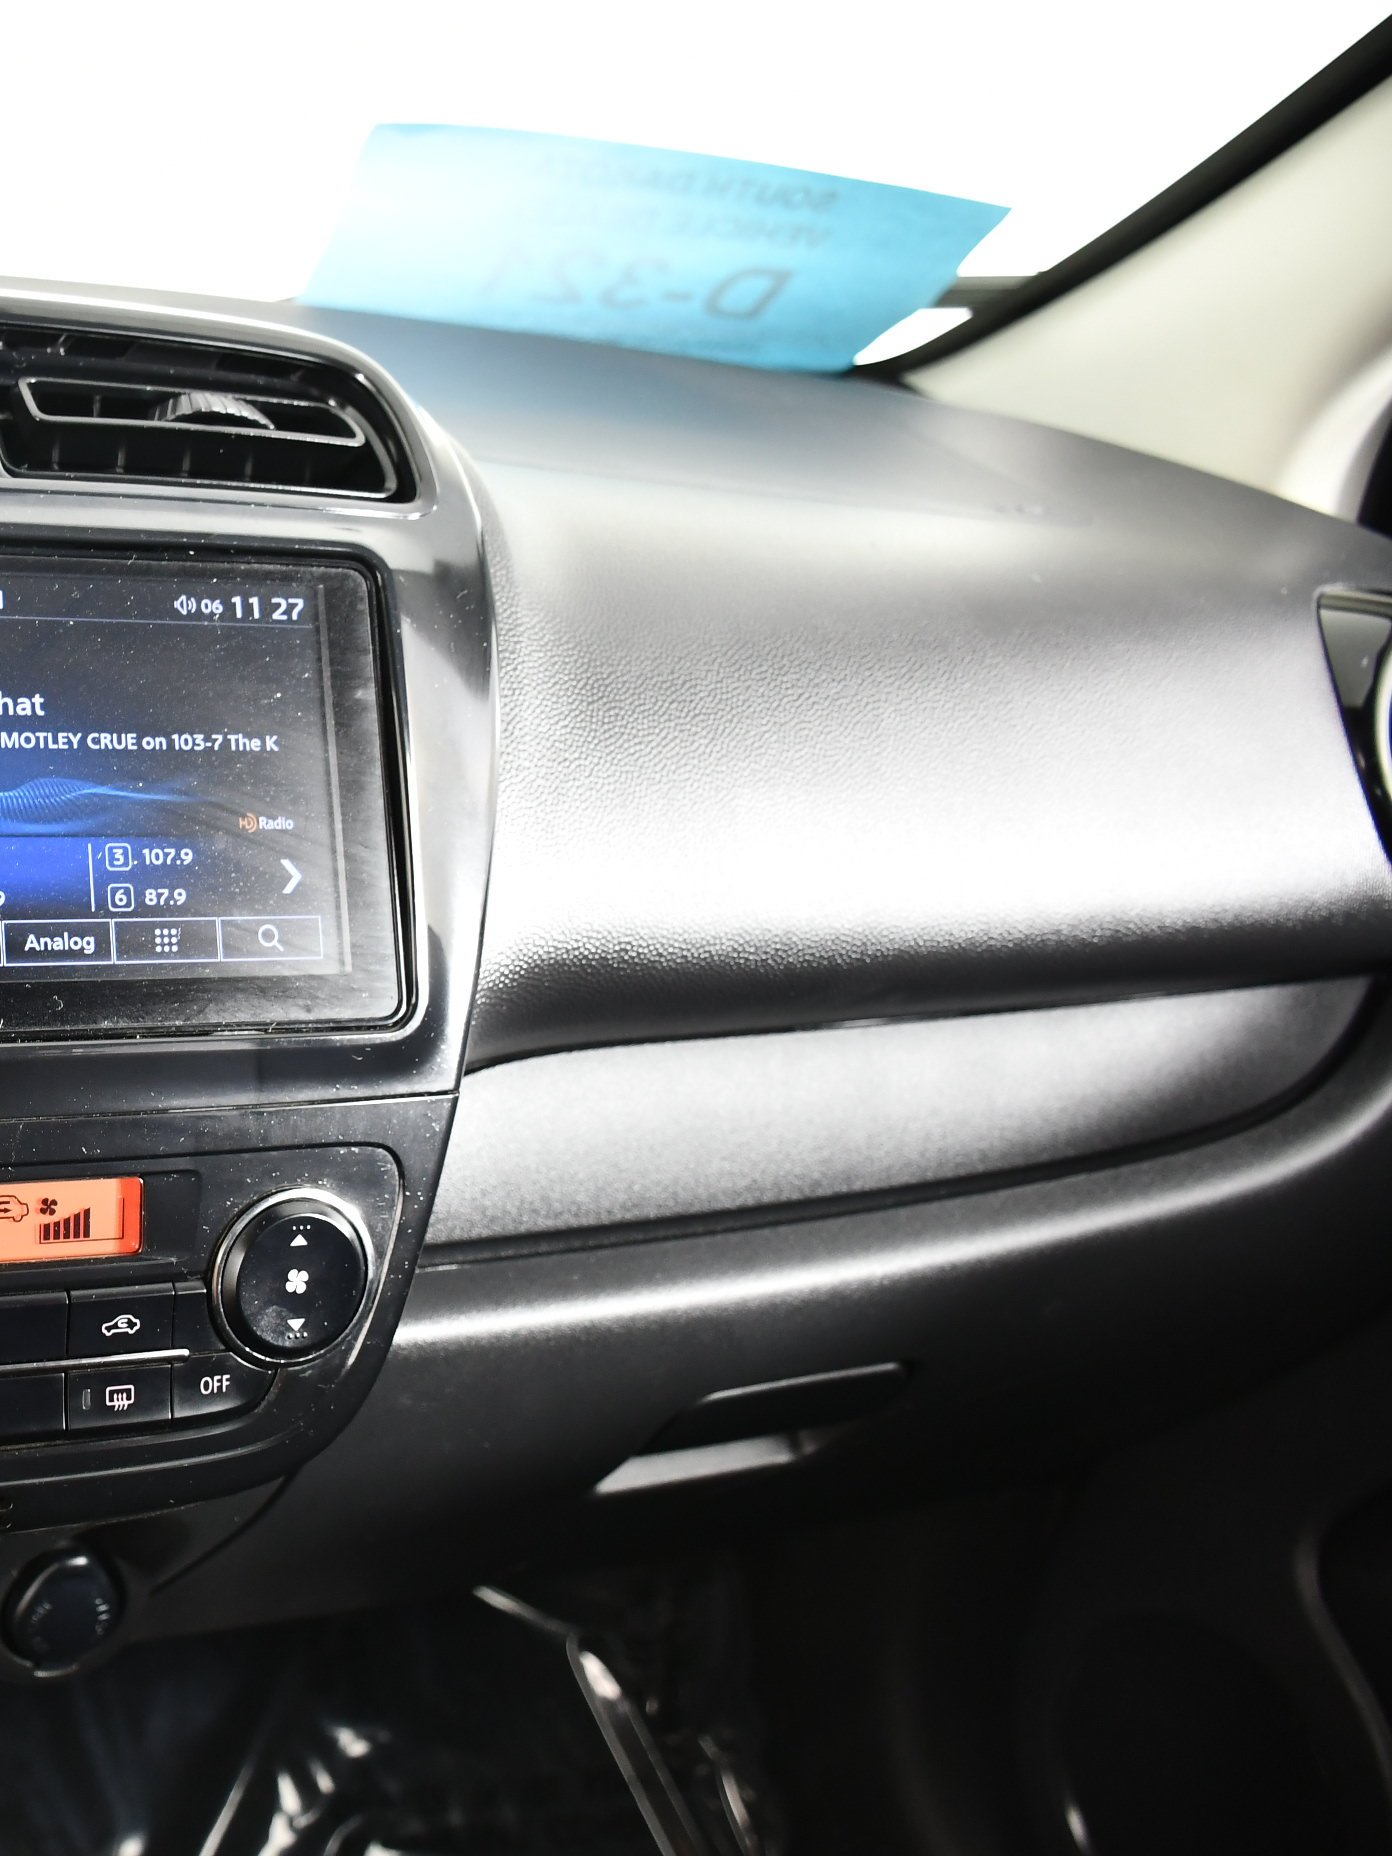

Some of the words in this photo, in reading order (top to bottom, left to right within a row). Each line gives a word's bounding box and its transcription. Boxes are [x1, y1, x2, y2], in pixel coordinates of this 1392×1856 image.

[200, 599, 224, 615] 06
[86, 732, 138, 750] CRUE
[141, 736, 167, 751] on
[171, 732, 224, 751] 103-7
[226, 733, 262, 752] The
[265, 735, 279, 752] K
[258, 816, 294, 830] Radio
[112, 849, 125, 865] 3
[141, 848, 194, 866] 107.9
[114, 889, 128, 906] 6
[144, 888, 187, 906] 87.9
[24, 931, 95, 955] Analog
[200, 1374, 231, 1395] OFF
